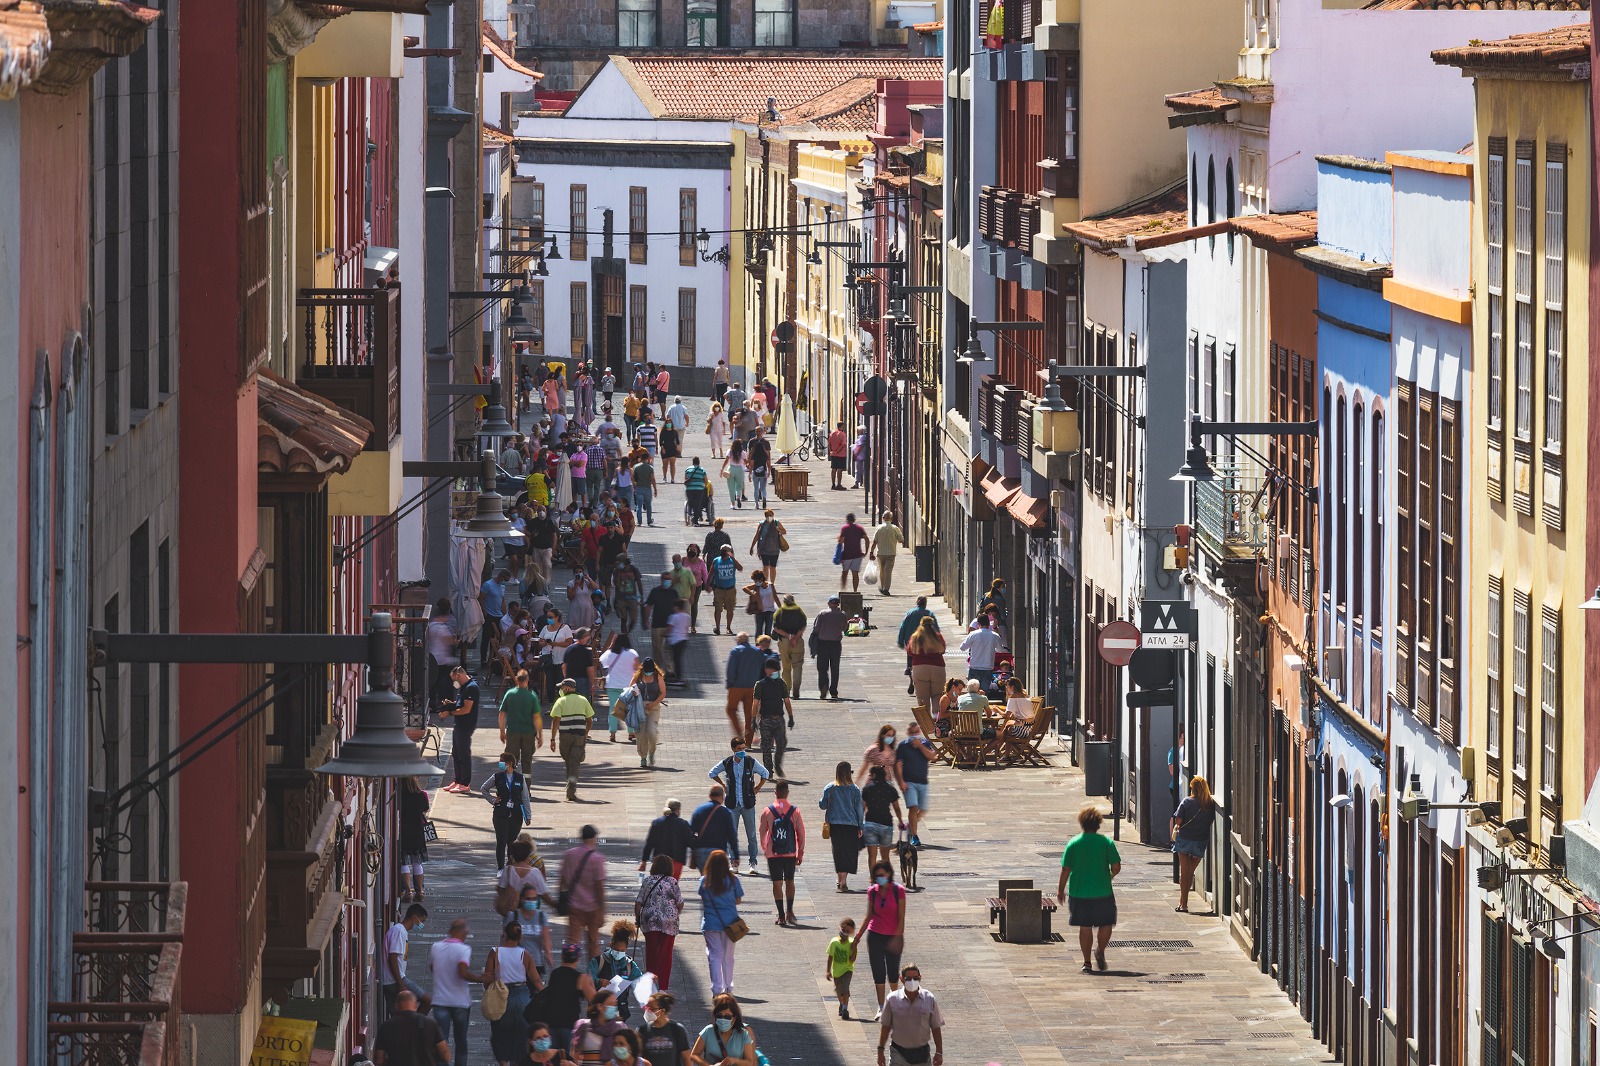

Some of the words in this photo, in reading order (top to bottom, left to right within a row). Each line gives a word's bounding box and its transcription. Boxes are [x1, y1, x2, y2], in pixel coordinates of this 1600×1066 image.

[718, 568, 733, 577] NYC
[1173, 635, 1185, 644] 24
[776, 827, 786, 839] NY
